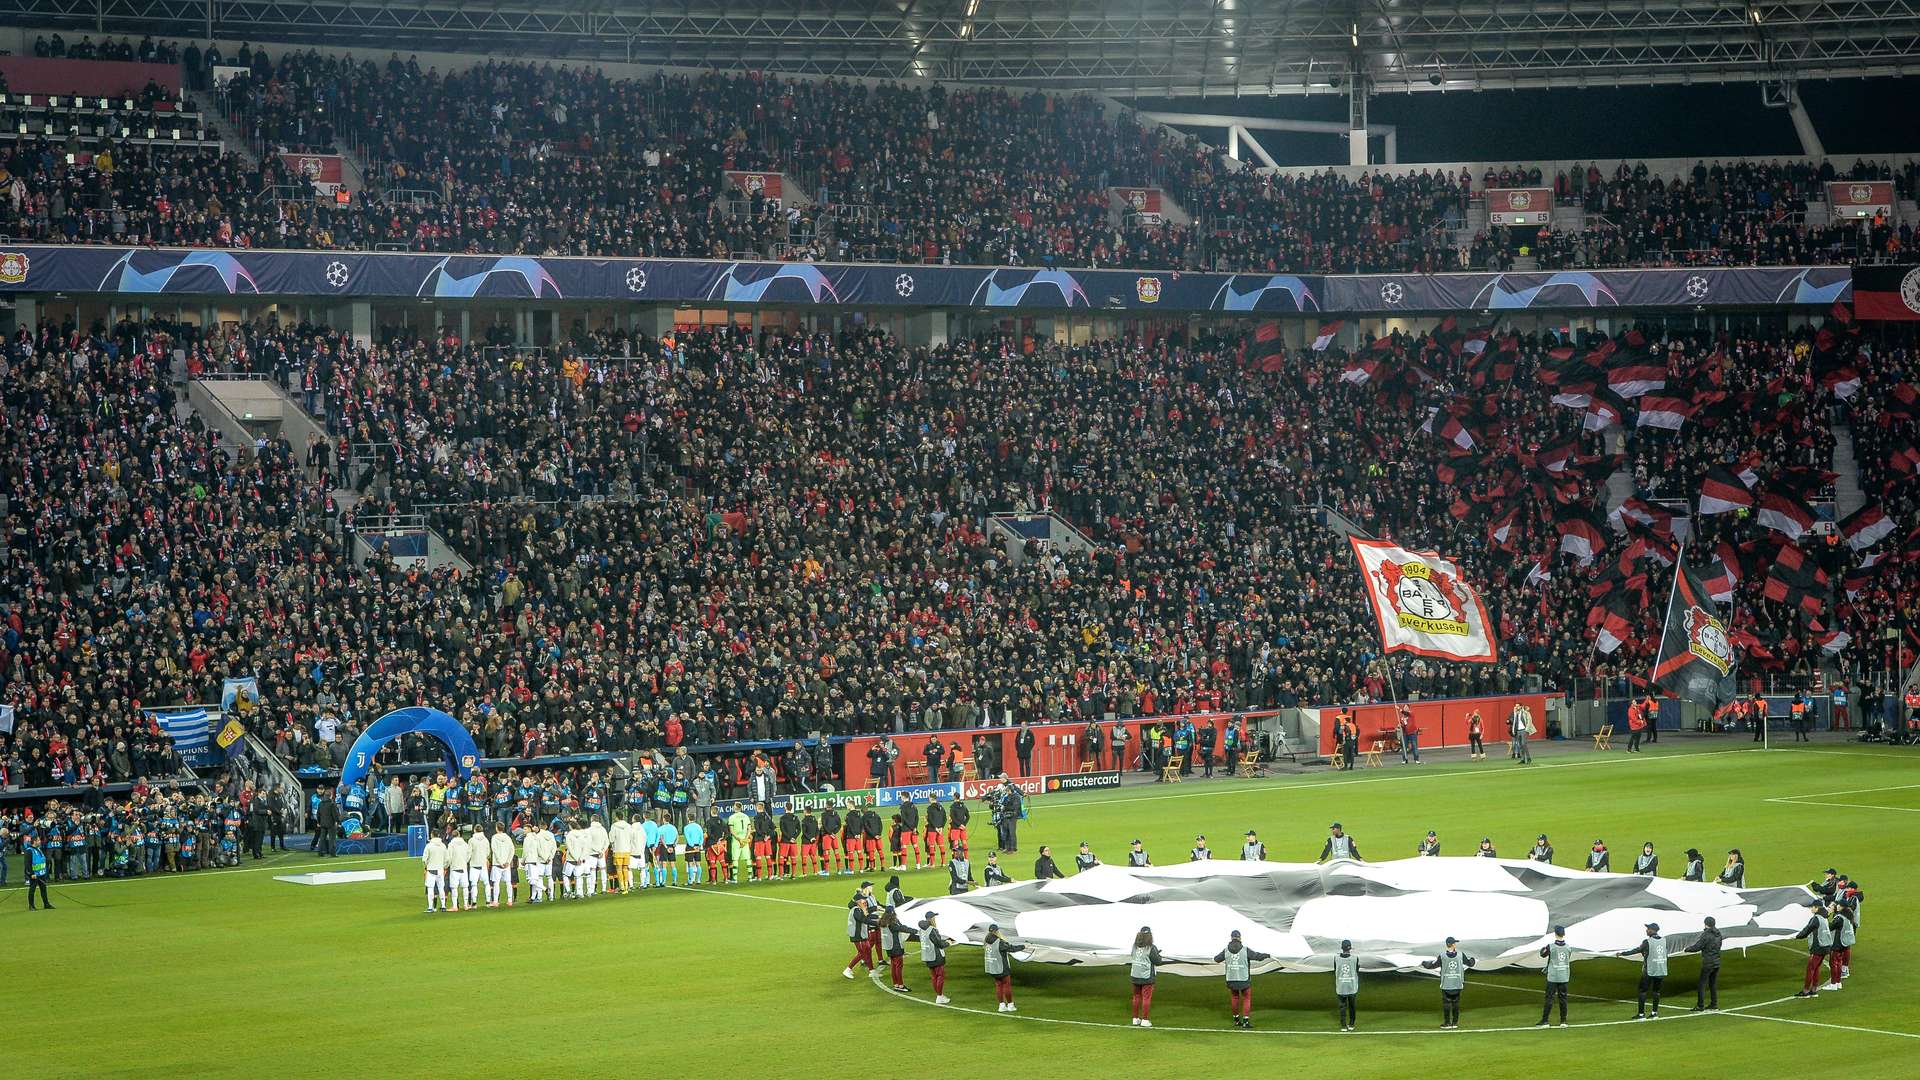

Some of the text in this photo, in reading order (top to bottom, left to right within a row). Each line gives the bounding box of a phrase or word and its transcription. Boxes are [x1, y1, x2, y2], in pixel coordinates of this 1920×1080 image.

[1492, 214, 1503, 222] E5
[1537, 213, 1548, 222] E5
[1405, 564, 1426, 575] 1904
[1062, 772, 1119, 788] mastercard
[795, 793, 862, 811] Heineken
[740, 819, 745, 830] 1
